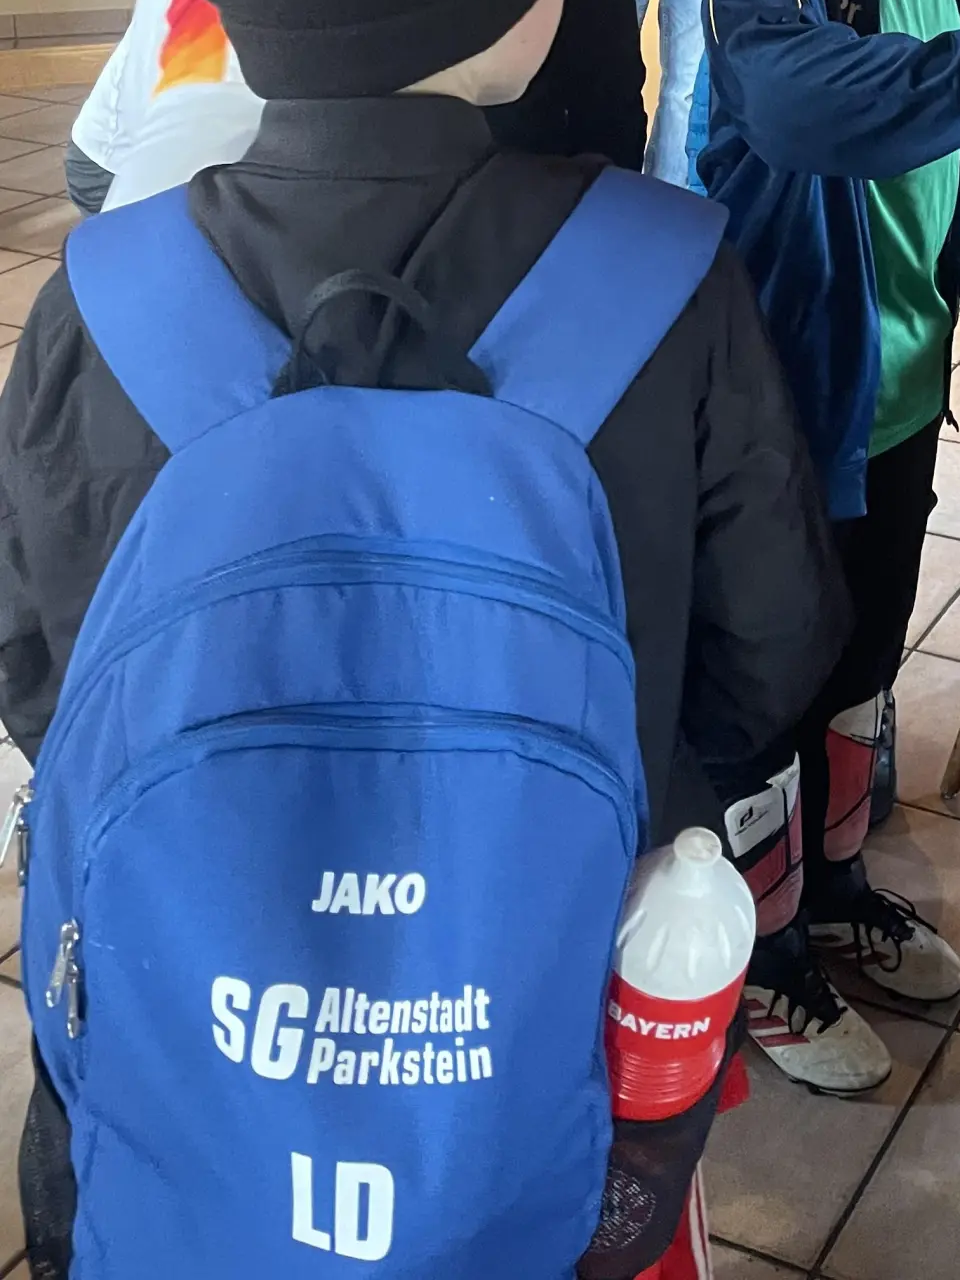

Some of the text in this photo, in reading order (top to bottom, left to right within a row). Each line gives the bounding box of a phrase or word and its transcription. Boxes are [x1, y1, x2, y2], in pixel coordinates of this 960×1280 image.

[311, 871, 426, 915] JAKO
[211, 976, 309, 1081] SG
[314, 984, 491, 1035] Altenstadt
[608, 1000, 711, 1040] BAYERN
[306, 1036, 493, 1086] Parkstein
[291, 1151, 395, 1261] LD
